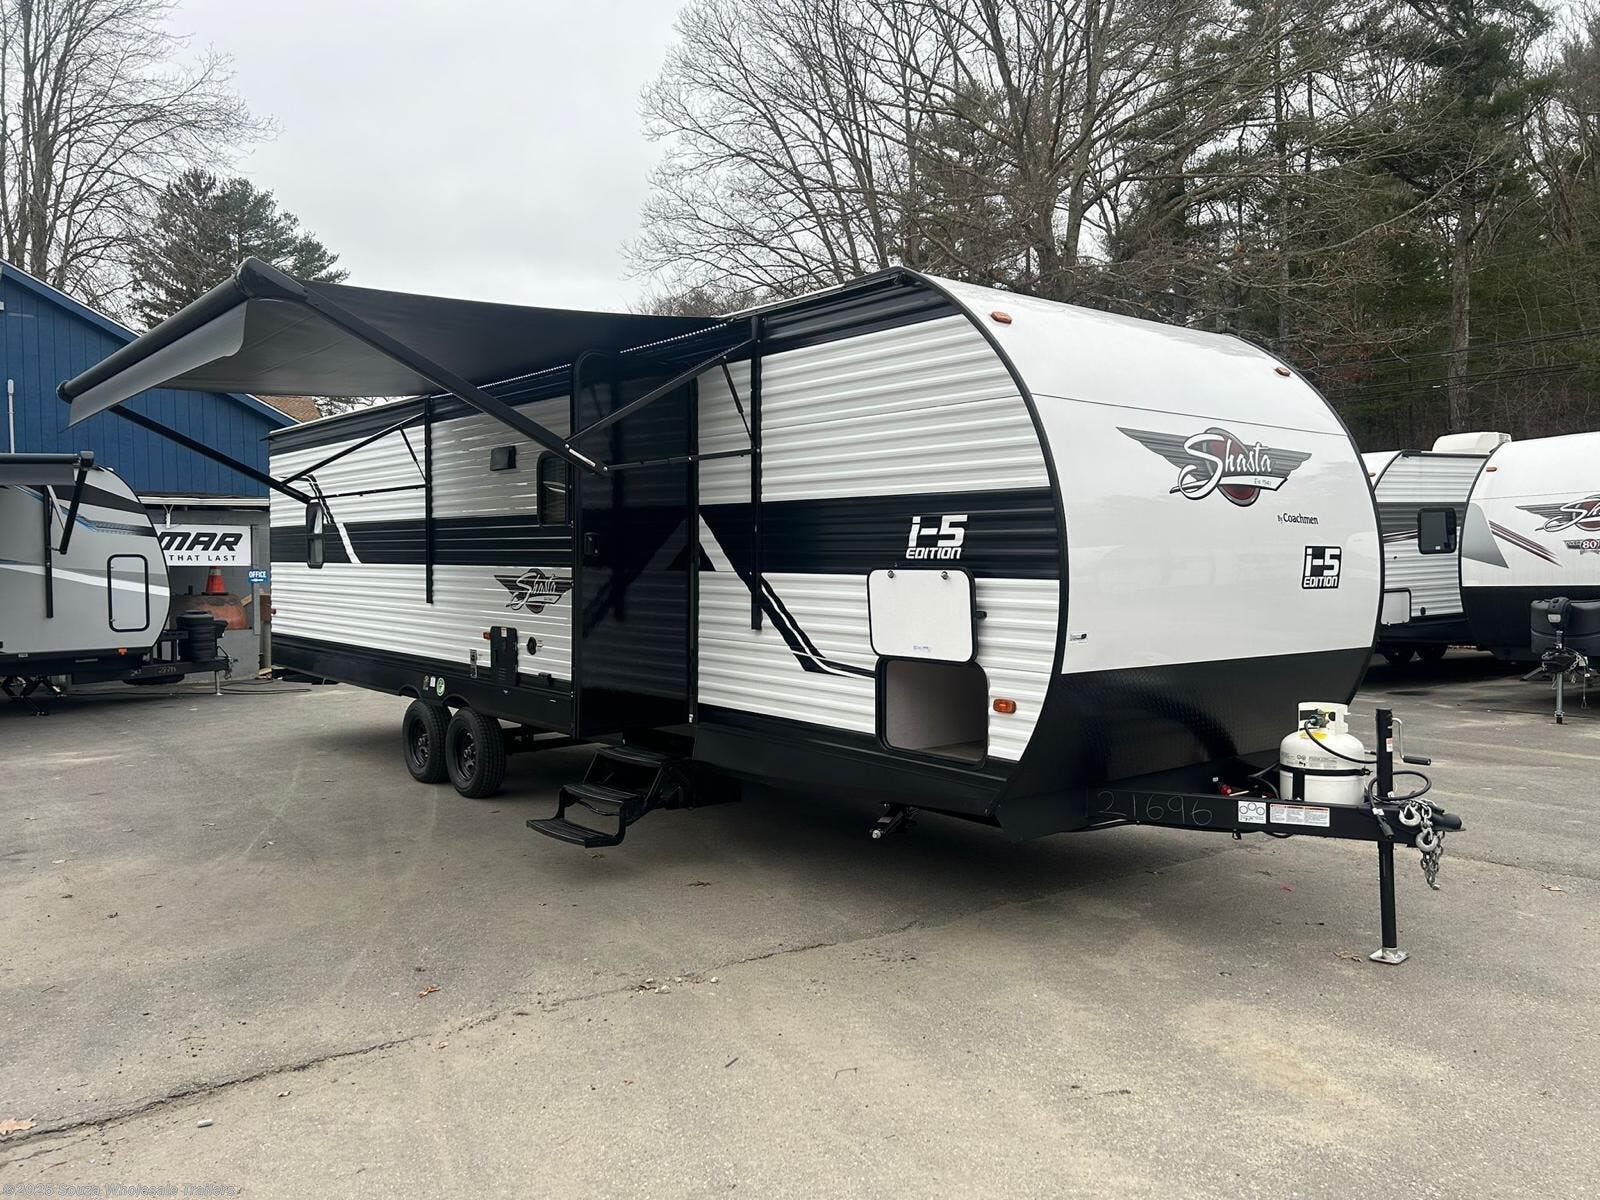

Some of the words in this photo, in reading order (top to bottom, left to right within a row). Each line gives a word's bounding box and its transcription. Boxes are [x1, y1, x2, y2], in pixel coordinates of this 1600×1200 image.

[1178, 433, 1272, 501] Shasta
[908, 514, 968, 547] i-5
[1283, 513, 1319, 525] Coachmen
[905, 547, 962, 559] EDITION
[1582, 540, 1597, 549] 80
[1304, 548, 1341, 577] i-5
[511, 571, 557, 610] Shasta
[1303, 576, 1338, 588] EDITION
[1098, 791, 1213, 826] 21696
